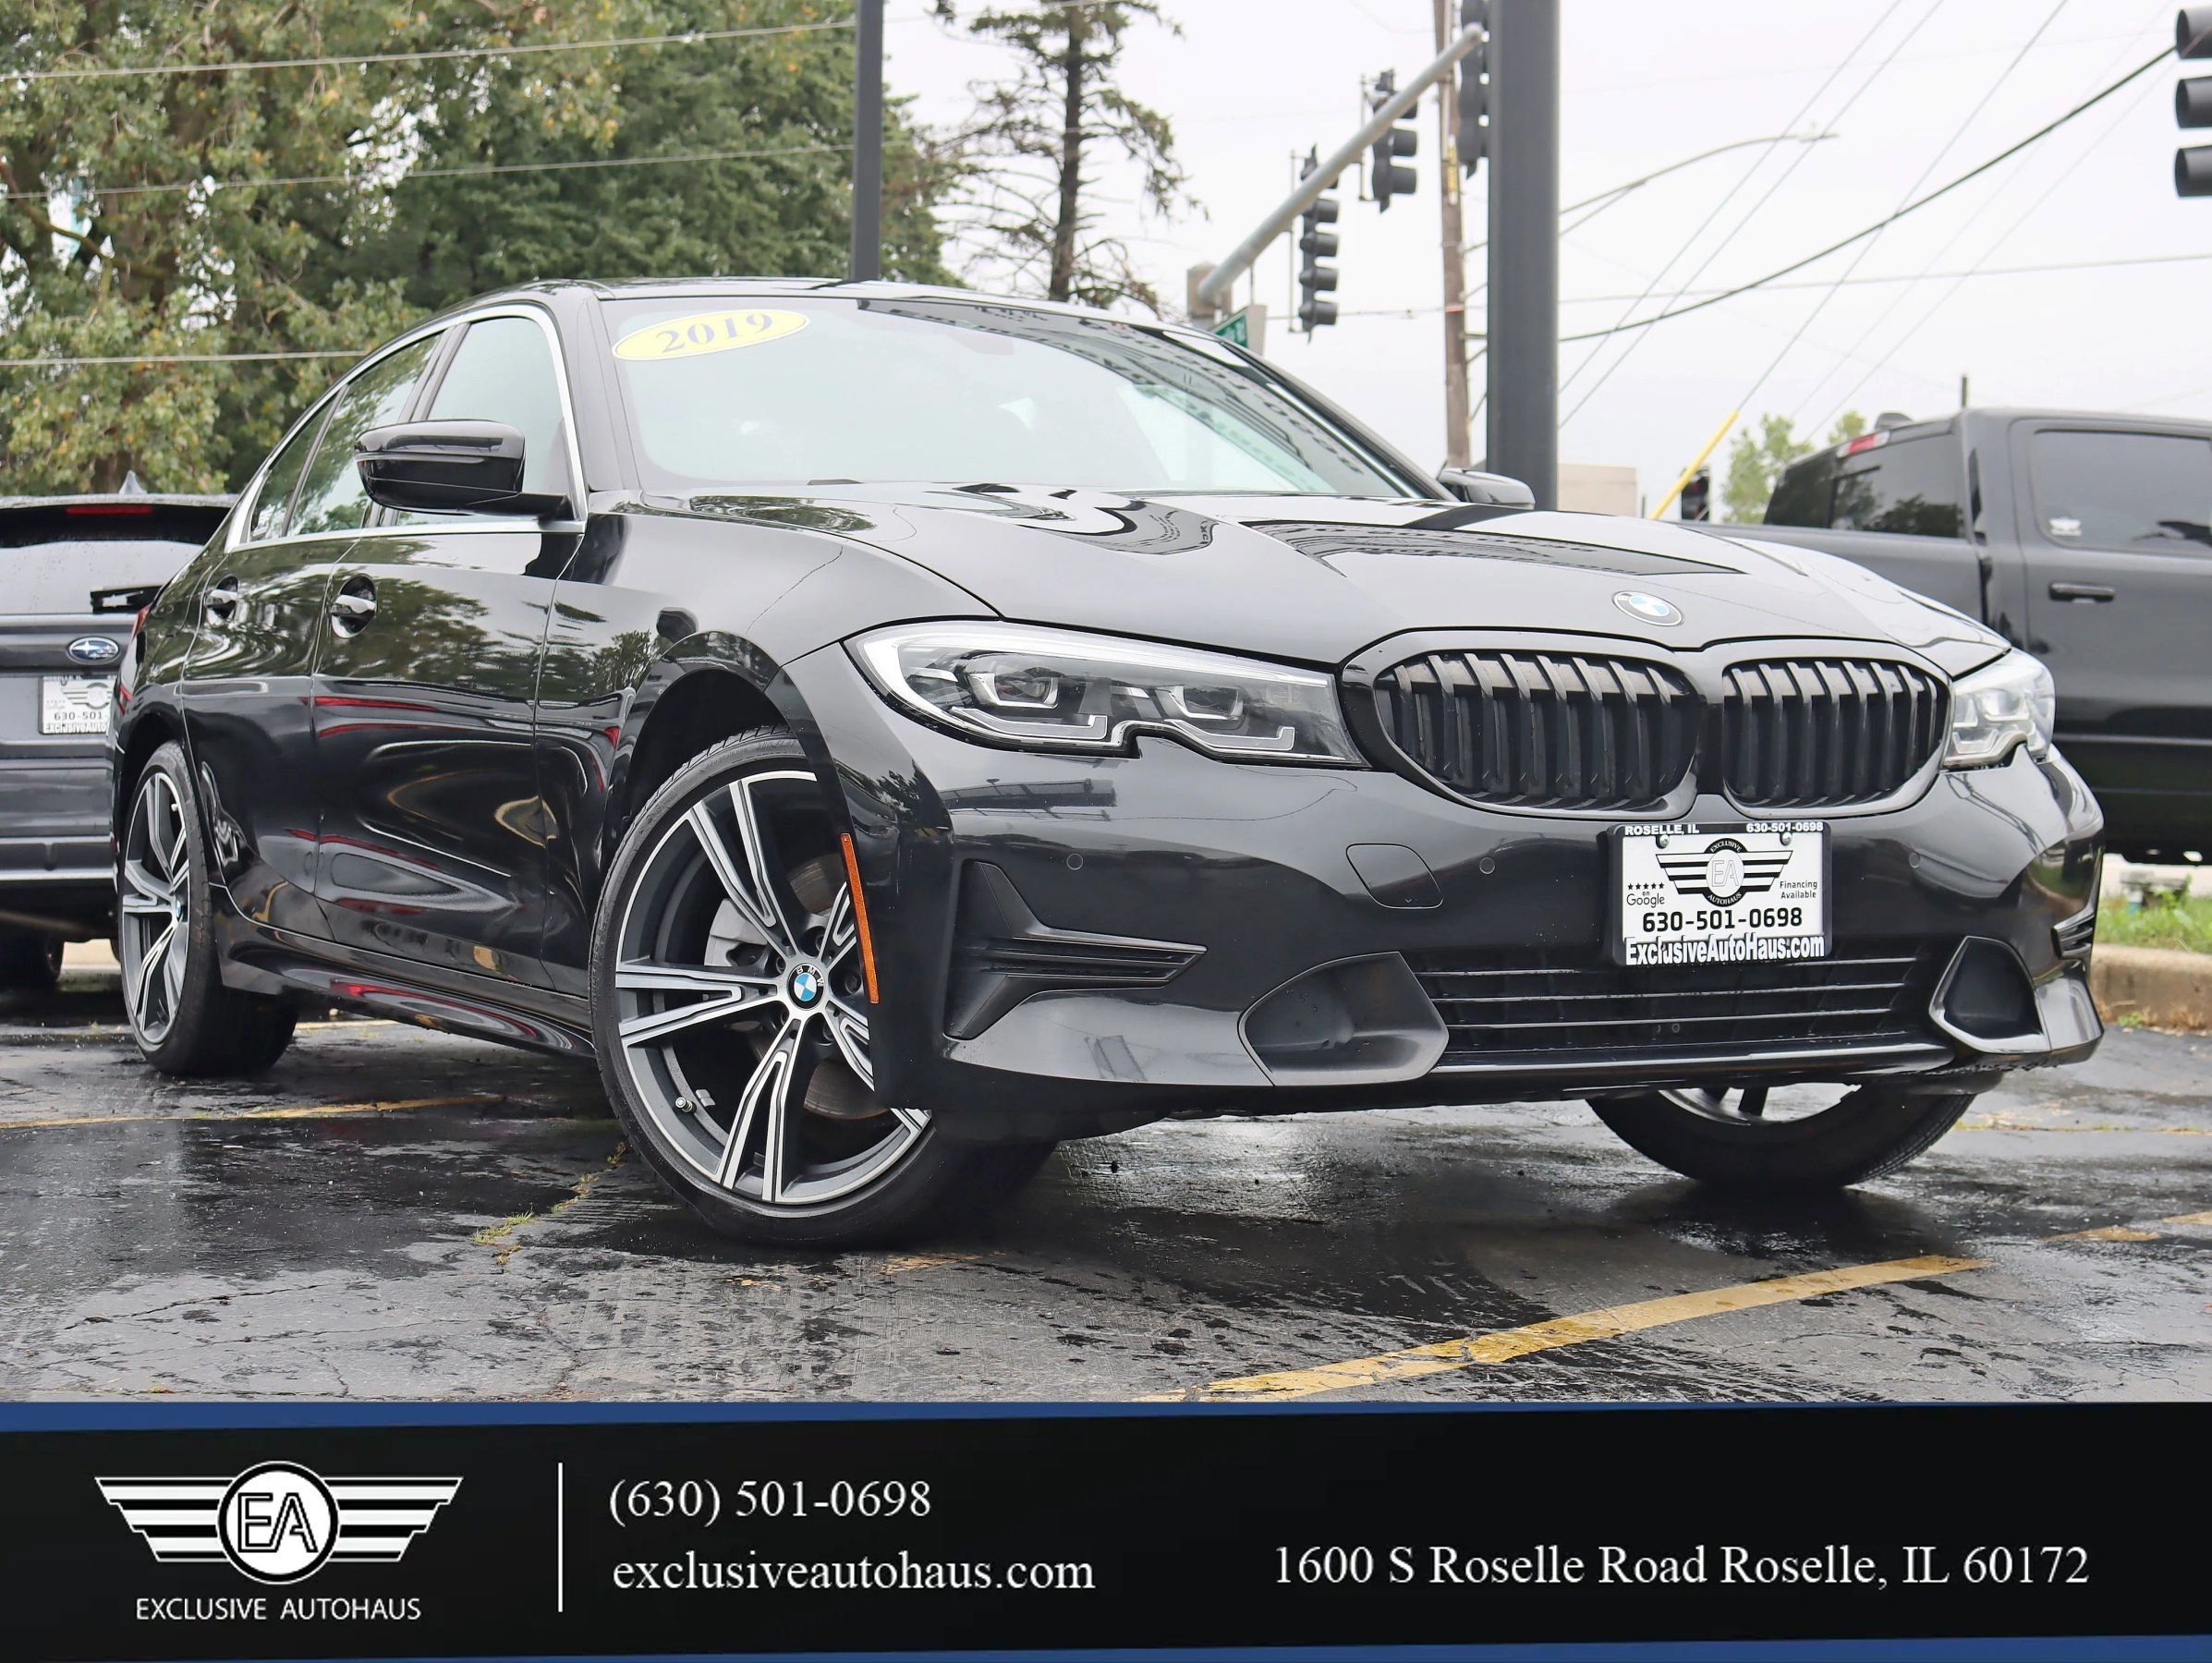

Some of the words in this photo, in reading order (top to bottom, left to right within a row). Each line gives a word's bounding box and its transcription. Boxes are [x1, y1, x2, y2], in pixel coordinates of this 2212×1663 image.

[656, 312, 773, 353] 2019
[1624, 824, 1684, 836] ROSELLE,
[1687, 823, 1700, 834] IL
[1745, 821, 1824, 832] 630-501-0698
[1710, 840, 1743, 853] EXCLUSIVE
[1780, 880, 1818, 890] Financing
[1626, 892, 1665, 908] Google
[1708, 891, 1743, 905] AUTOHAUS
[1781, 890, 1817, 899] Available
[1642, 907, 1803, 932] 630-501-0698
[1625, 932, 1825, 965] ExclusiveAutoHaus.com
[796, 965, 825, 988] BMW
